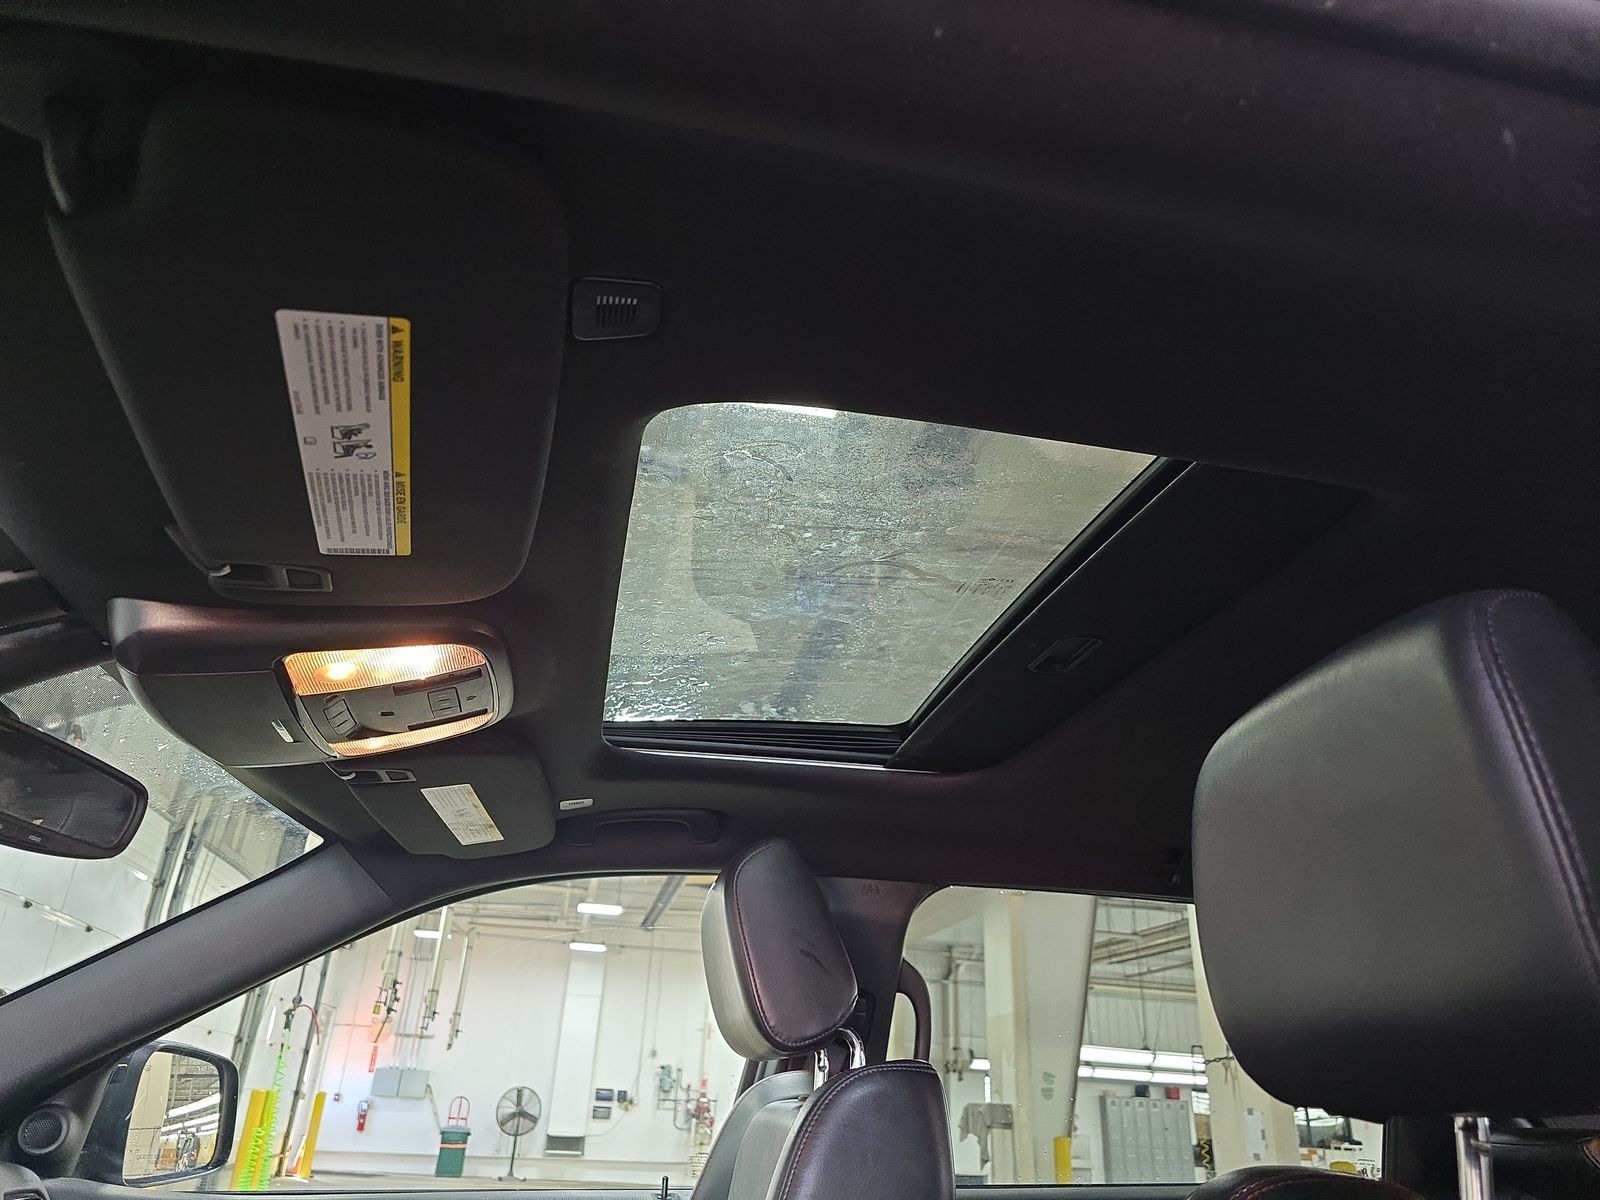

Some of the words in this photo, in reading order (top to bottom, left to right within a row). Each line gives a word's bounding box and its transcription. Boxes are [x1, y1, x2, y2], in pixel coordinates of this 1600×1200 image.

[392, 340, 405, 382] WARNING
[396, 481, 406, 496] MISE
[397, 506, 407, 524] GARDE
